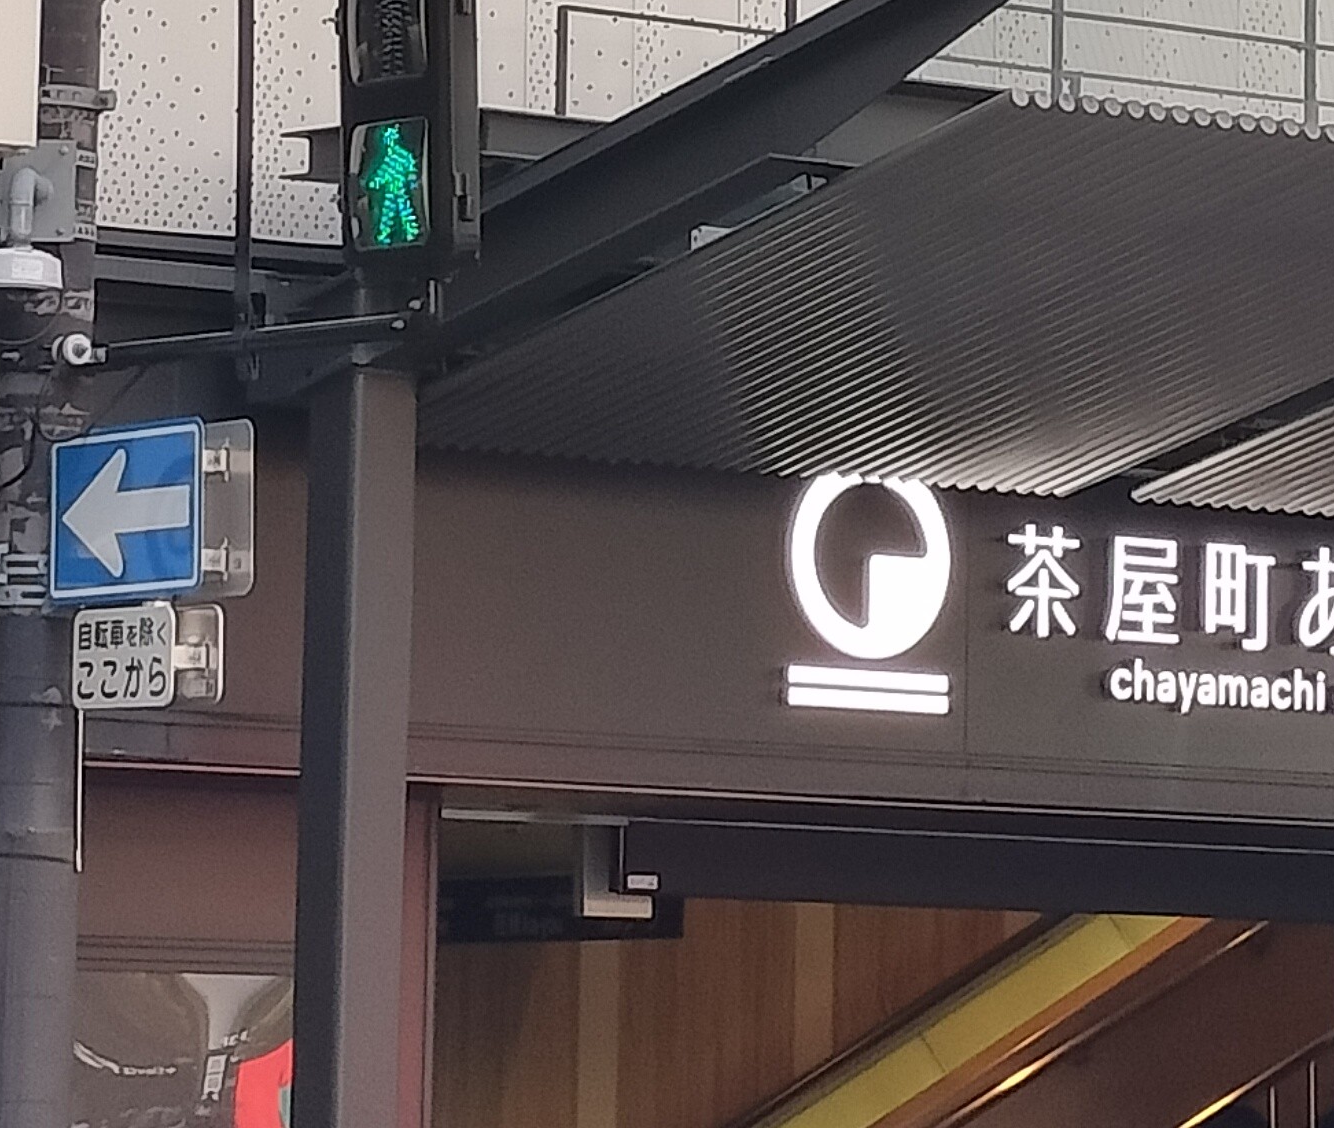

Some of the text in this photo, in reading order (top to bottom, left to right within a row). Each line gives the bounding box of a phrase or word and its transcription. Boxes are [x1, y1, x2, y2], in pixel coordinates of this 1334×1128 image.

[78, 616, 167, 651] 自転車を除く
[77, 656, 167, 700] ここから
[1109, 658, 1327, 715] chayamachi
